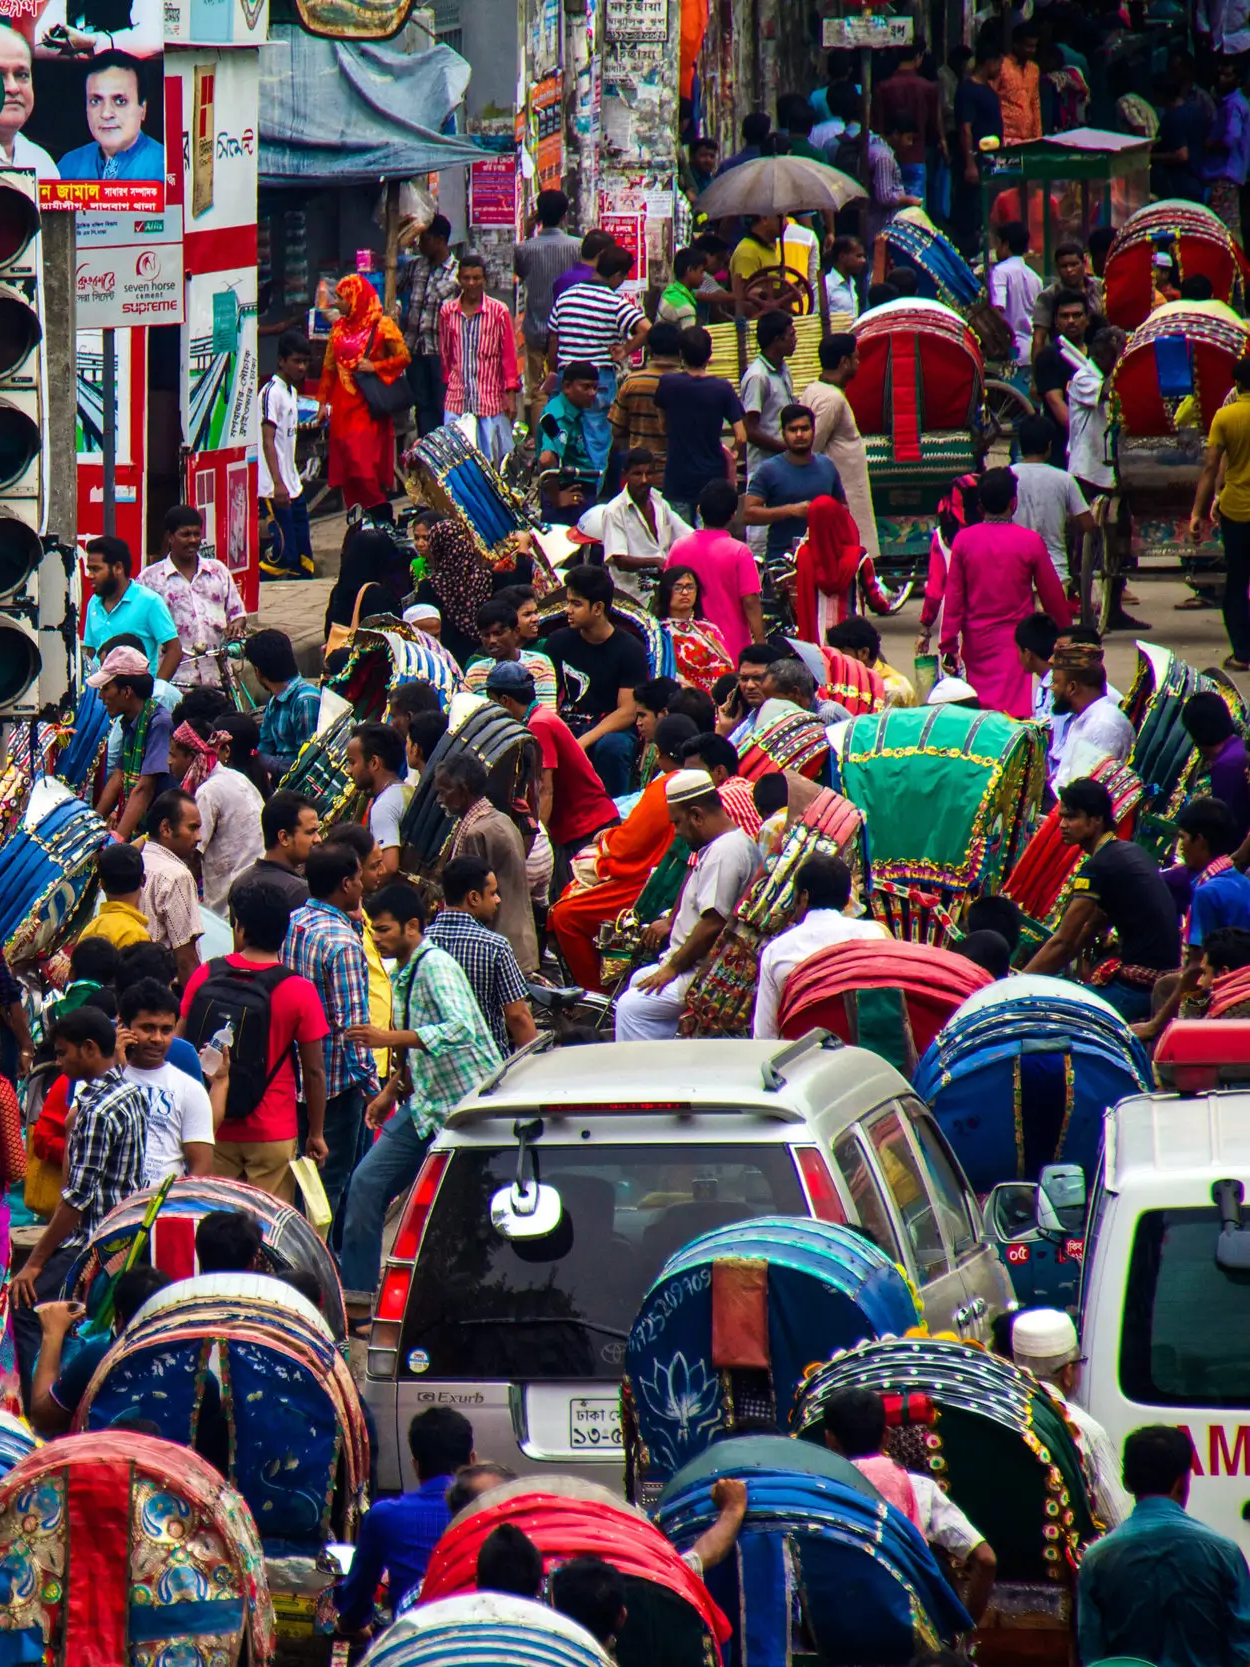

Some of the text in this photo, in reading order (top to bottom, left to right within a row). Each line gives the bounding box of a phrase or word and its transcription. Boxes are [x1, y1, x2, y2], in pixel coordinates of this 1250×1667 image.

[216, 127, 254, 161] সিমেন্ট
[56, 183, 100, 200] জামাল
[104, 187, 128, 197] সাধারণ
[124, 281, 176, 293] seven horse
[136, 291, 163, 300] cement
[437, 1391, 484, 1404] Exurb
[576, 1409, 605, 1422] ঢাকা
